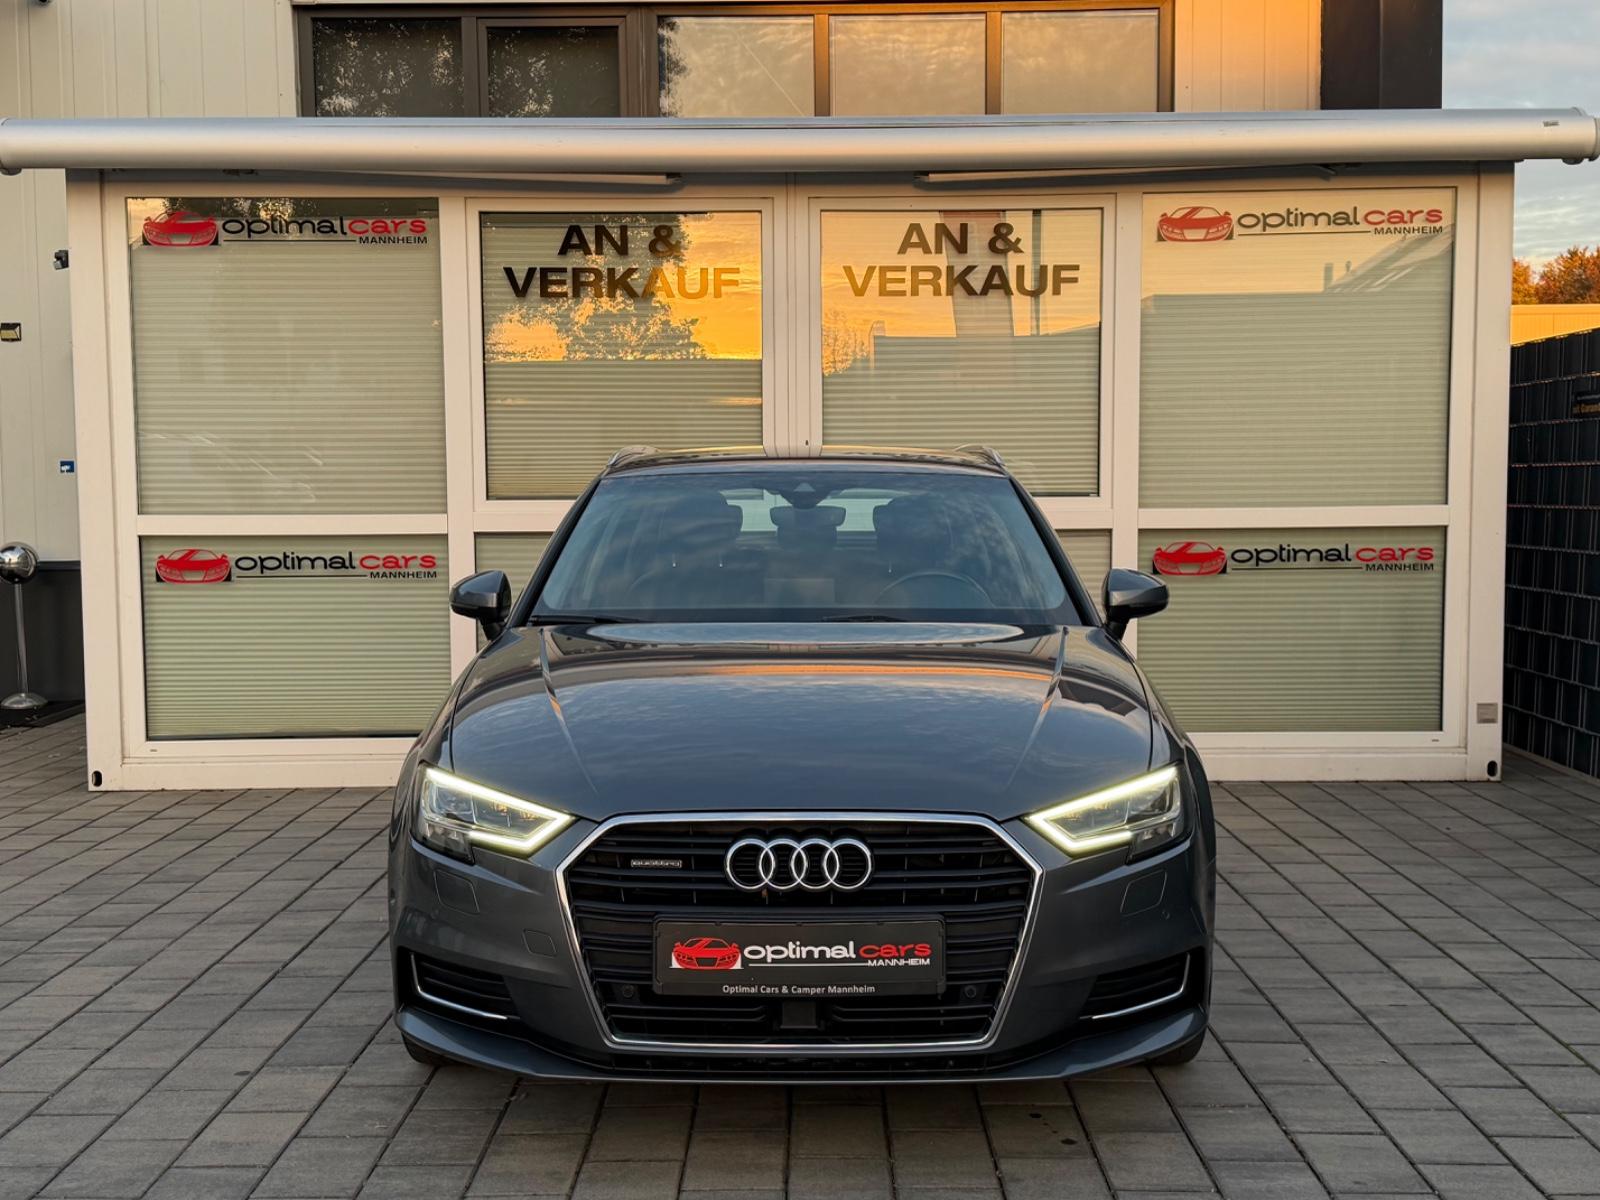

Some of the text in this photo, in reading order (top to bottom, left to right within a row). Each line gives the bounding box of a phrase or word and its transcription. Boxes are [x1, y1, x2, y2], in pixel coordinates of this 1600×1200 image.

[1373, 226, 1443, 236] MANNHEIM
[358, 235, 428, 245] MANNHEIM
[557, 224, 681, 257] AN &
[897, 223, 1024, 255] AN &
[503, 266, 740, 299] VERKAUF
[842, 264, 1080, 297] VERKAUF
[1365, 563, 1434, 573] MANNHEIM
[369, 570, 437, 580] MANNHEIM
[743, 940, 932, 963] optimal cars
[867, 957, 930, 967] MANNHEIM
[722, 984, 876, 996] Optimal Cars & Camper Mannheim
